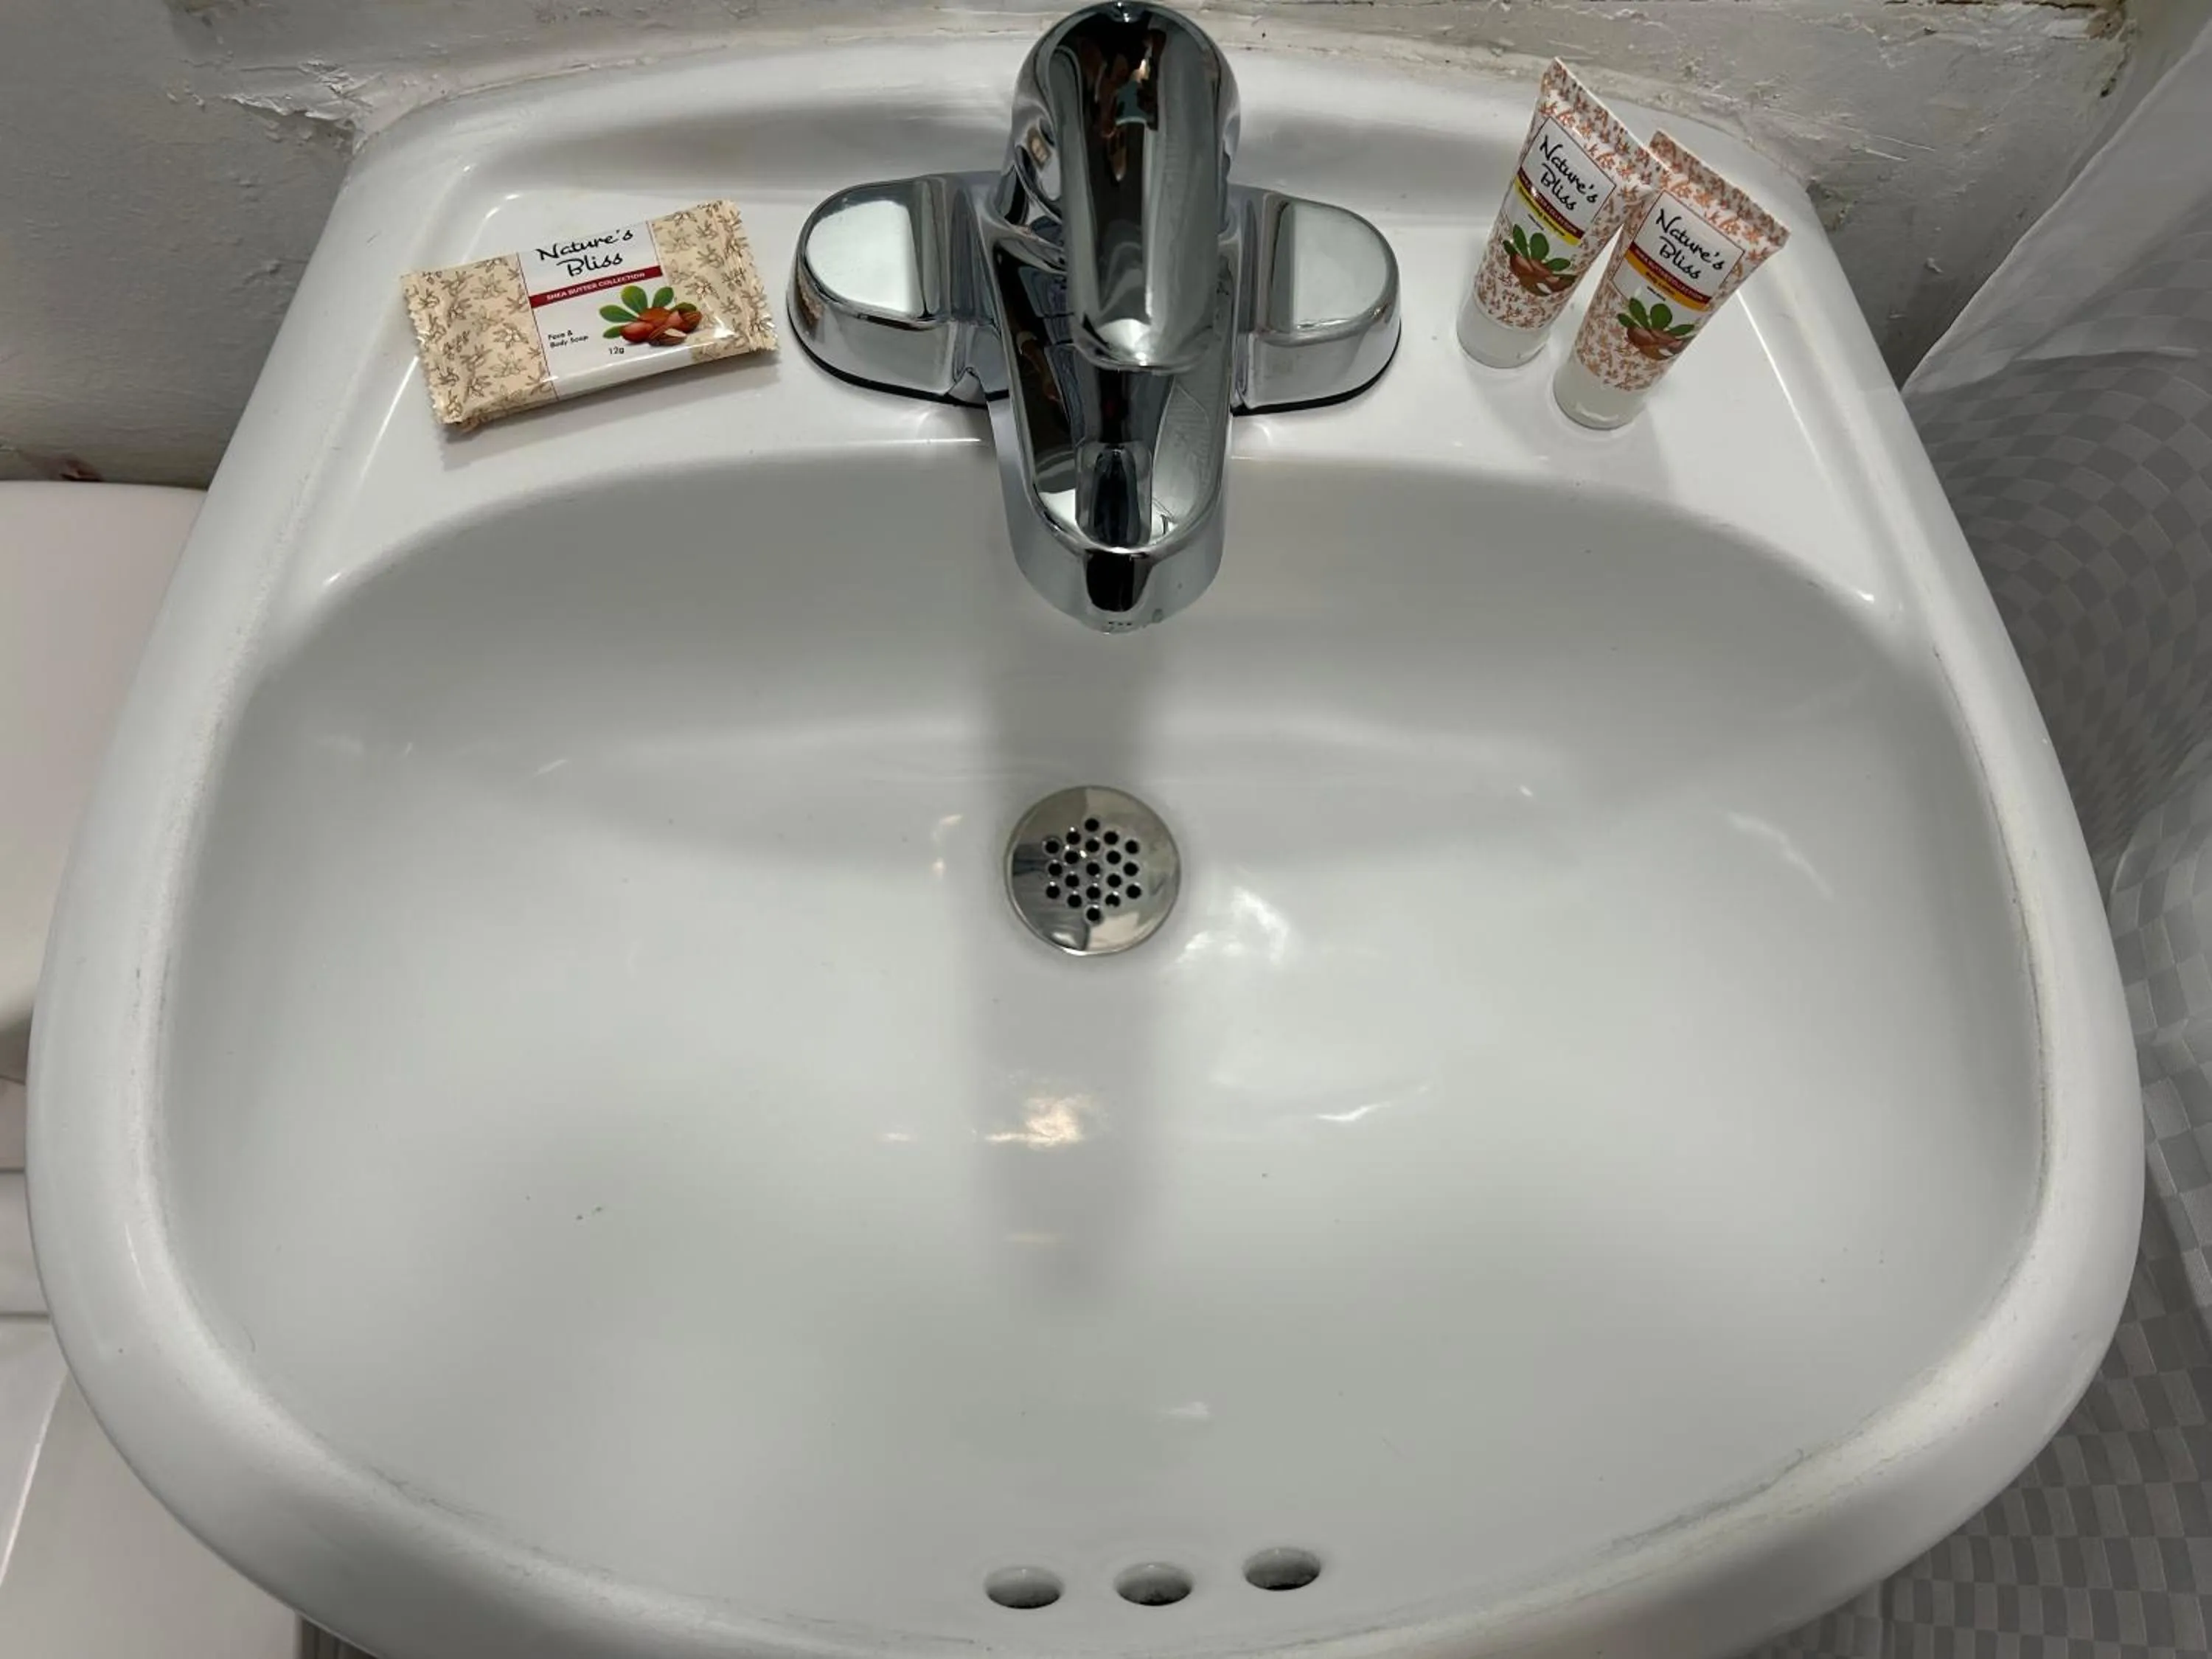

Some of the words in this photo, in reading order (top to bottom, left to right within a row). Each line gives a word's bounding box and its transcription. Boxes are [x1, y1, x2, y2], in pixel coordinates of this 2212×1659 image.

[1540, 135, 1598, 203] Nature's
[1540, 163, 1576, 210] Bliss
[535, 229, 633, 260] Nature's
[1656, 209, 1725, 270] Nature's
[1659, 236, 1701, 279] Bliss
[556, 253, 624, 276] Bliss
[599, 273, 645, 288] COLLECTION
